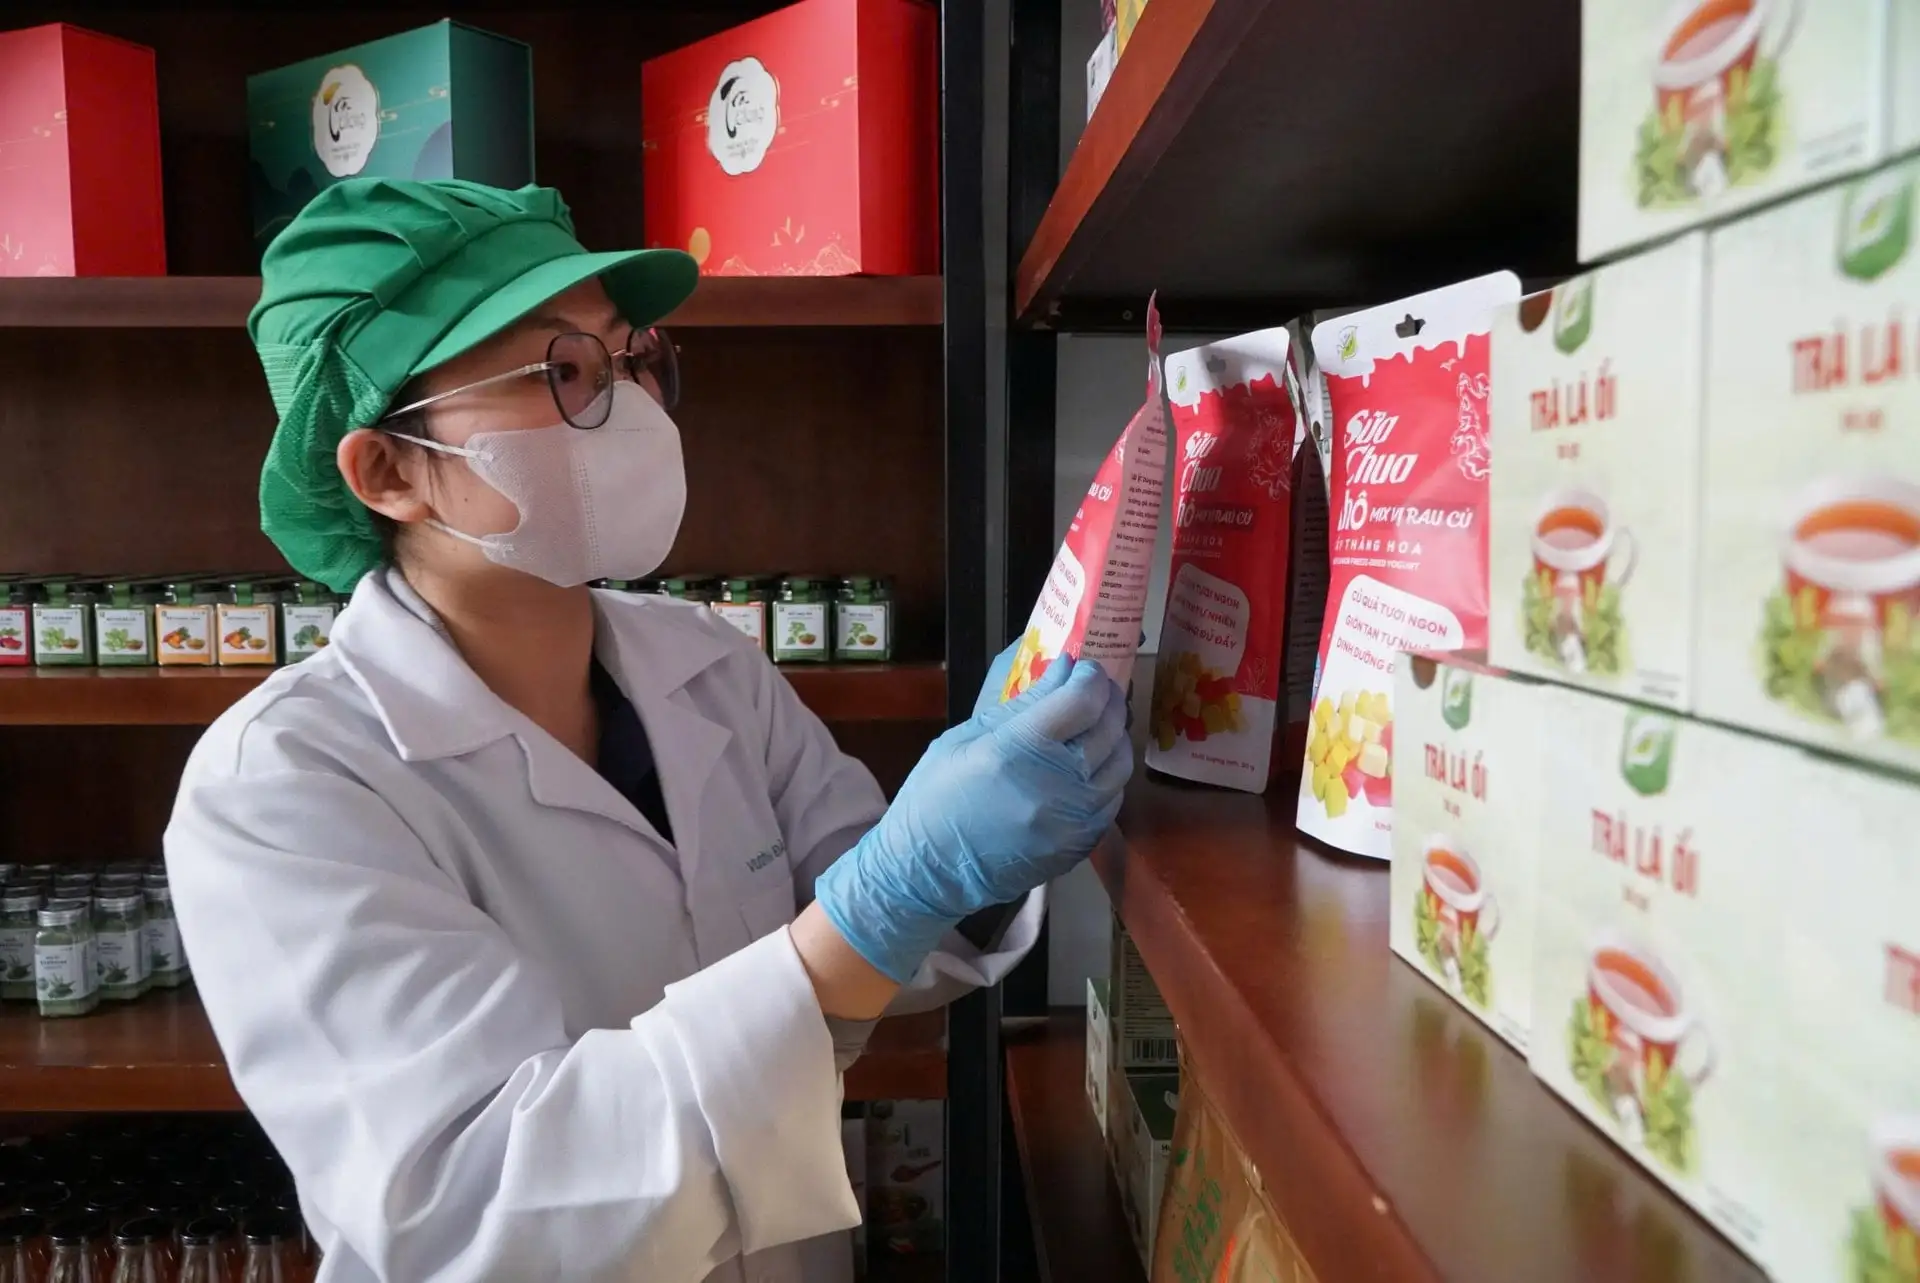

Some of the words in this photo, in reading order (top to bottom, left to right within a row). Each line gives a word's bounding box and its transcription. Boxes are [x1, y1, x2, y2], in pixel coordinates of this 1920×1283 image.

[1406, 507, 1444, 526] RAU
[1387, 541, 1422, 555] HOA
[1407, 615, 1448, 637] NGON
